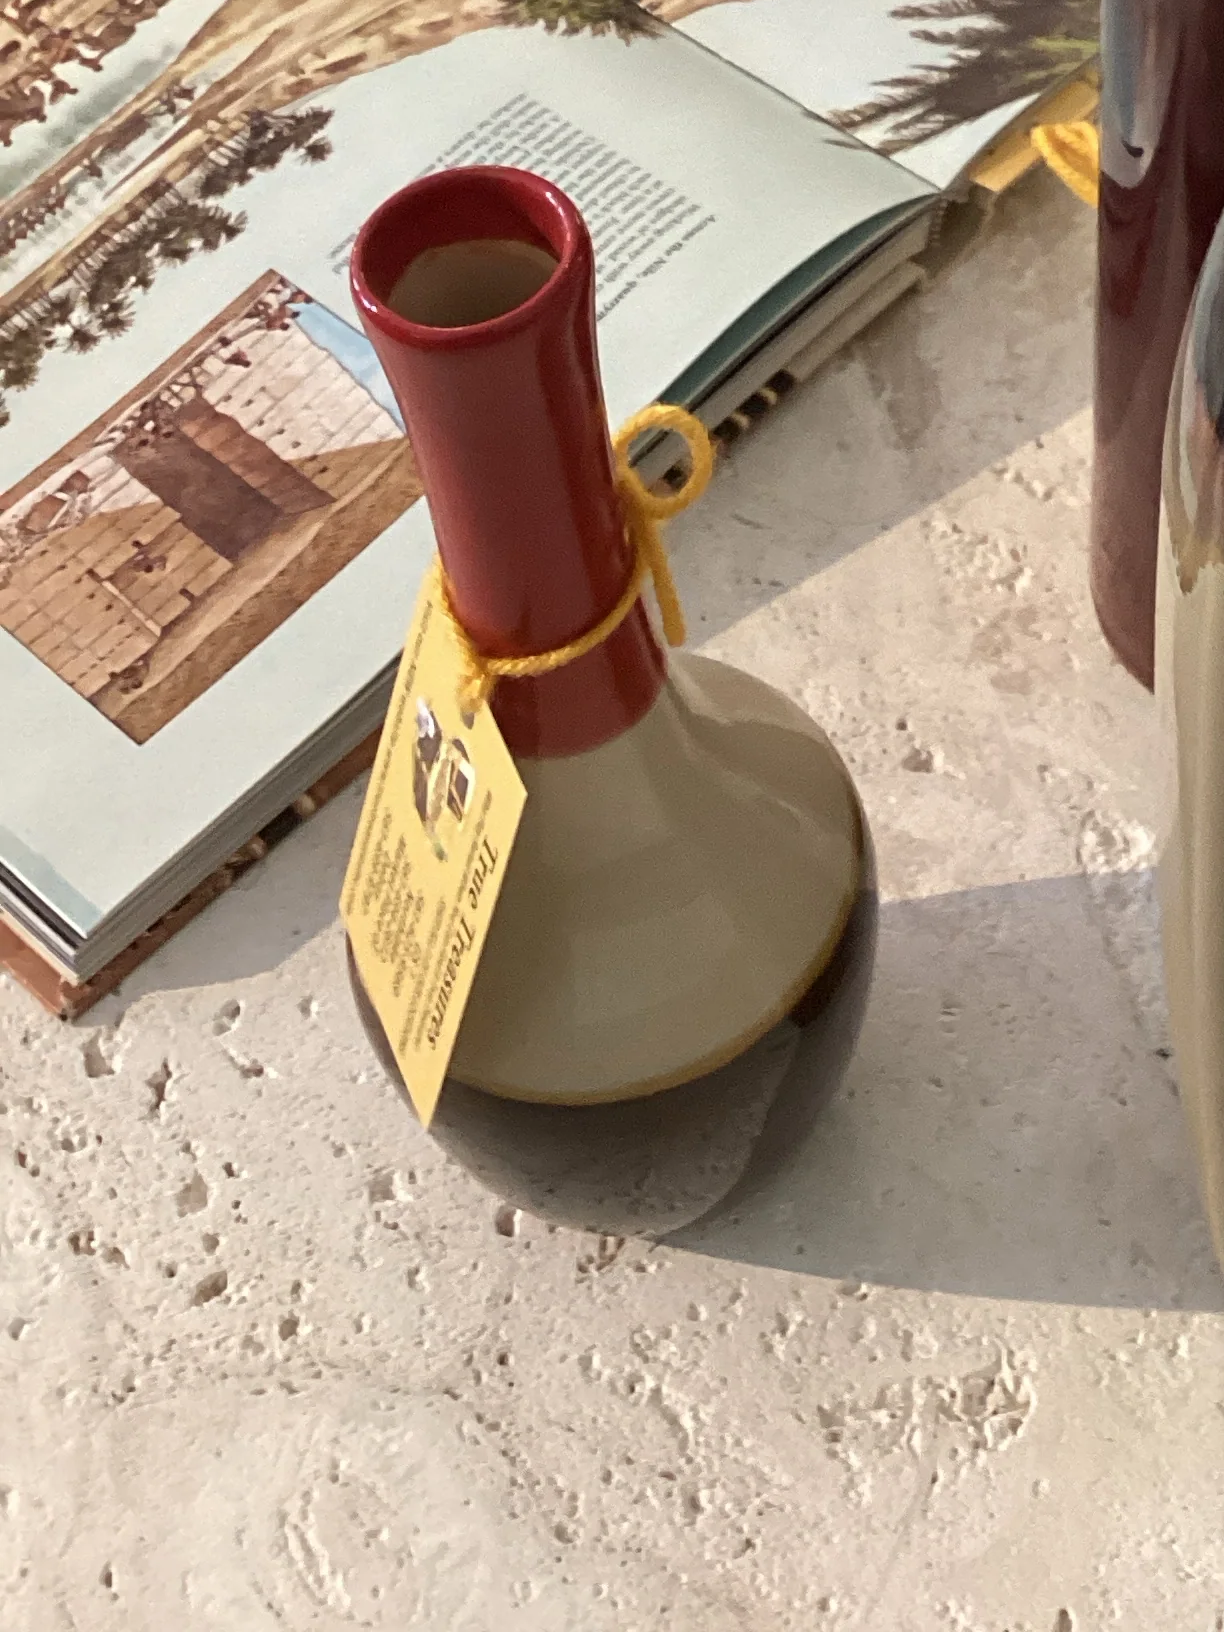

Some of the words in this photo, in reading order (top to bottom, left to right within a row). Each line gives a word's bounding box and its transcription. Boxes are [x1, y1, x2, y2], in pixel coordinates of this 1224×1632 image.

[664, 241, 684, 257] the
[468, 835, 499, 909] True
[427, 912, 476, 1050] Treasures
